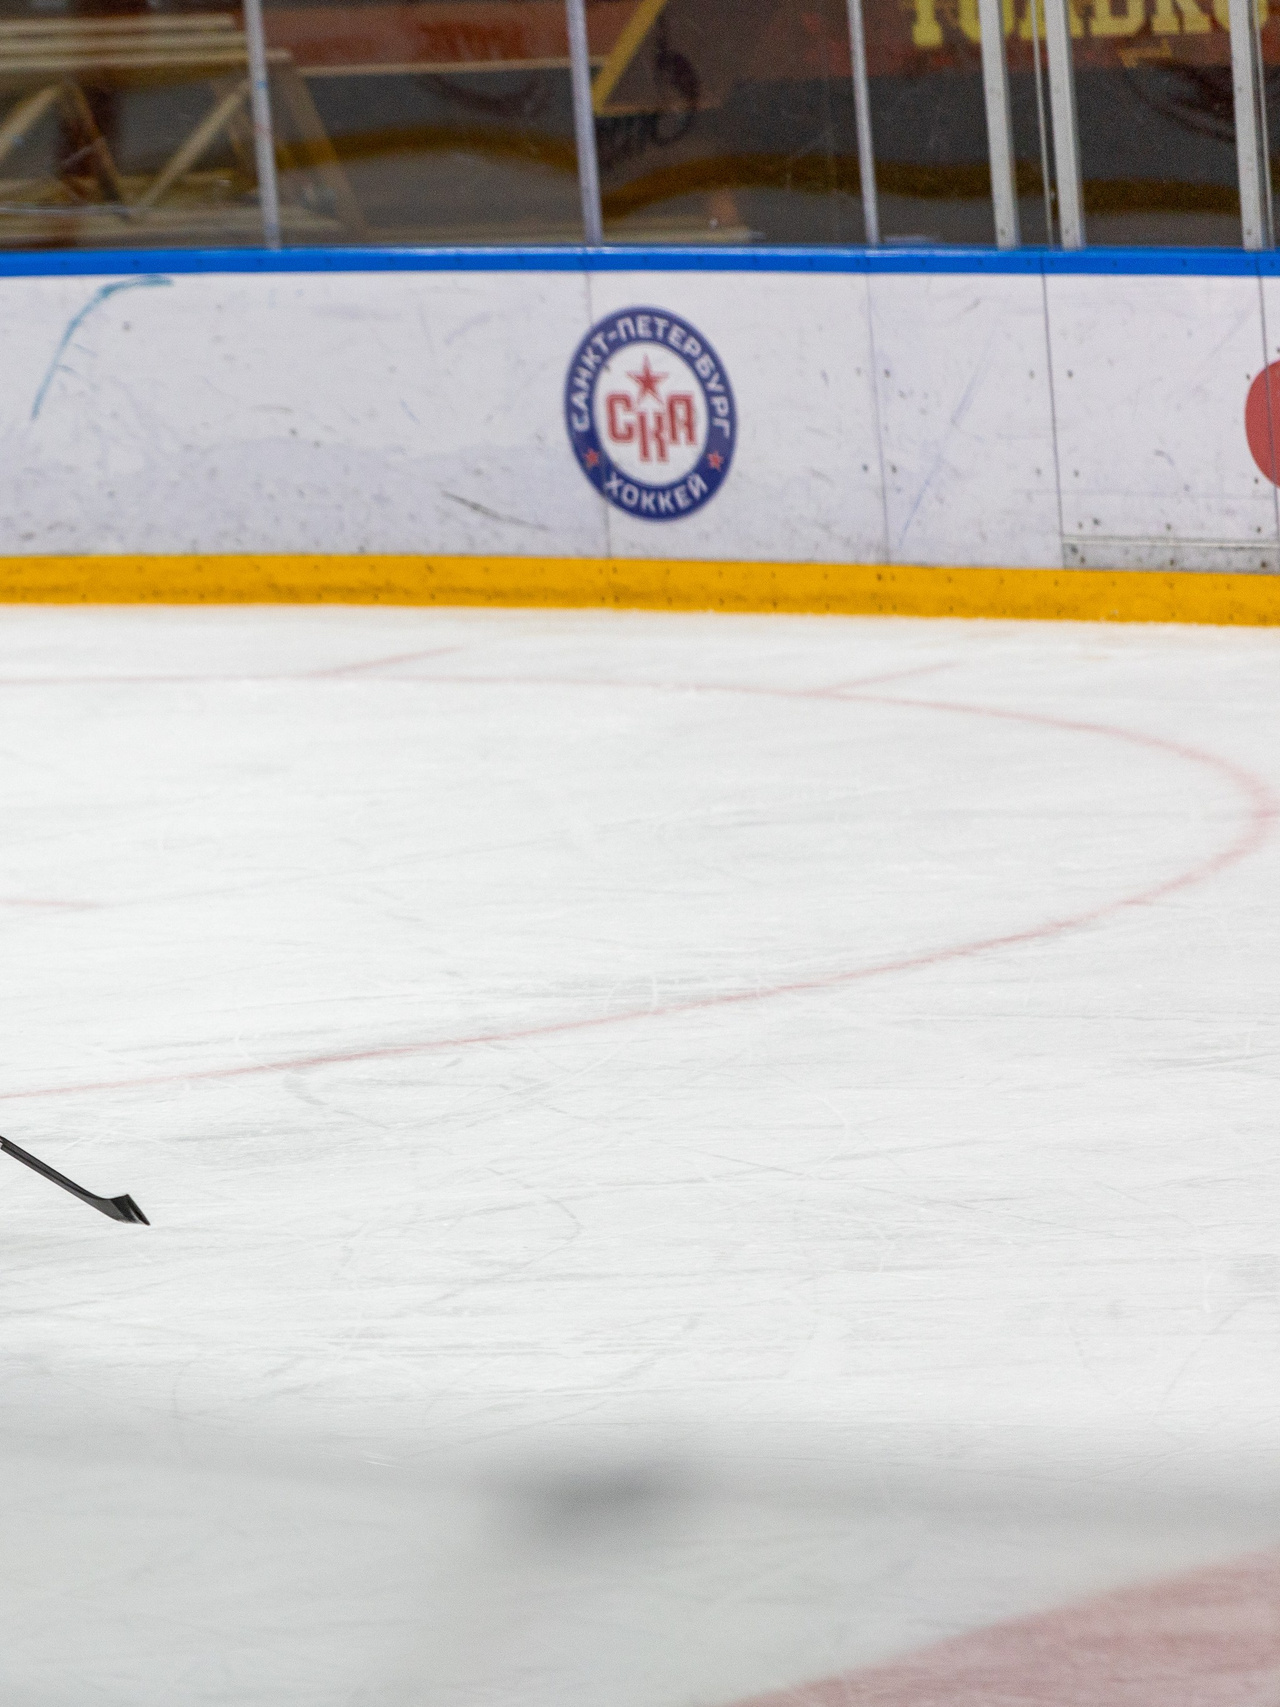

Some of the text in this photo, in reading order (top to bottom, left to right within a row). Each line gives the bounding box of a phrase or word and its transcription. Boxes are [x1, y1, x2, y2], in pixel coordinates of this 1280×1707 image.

[571, 314, 730, 439] САНКТ-ПЕТЕРБУРГ
[605, 391, 698, 463] СКА
[604, 472, 709, 513] ХОККЕЙ
